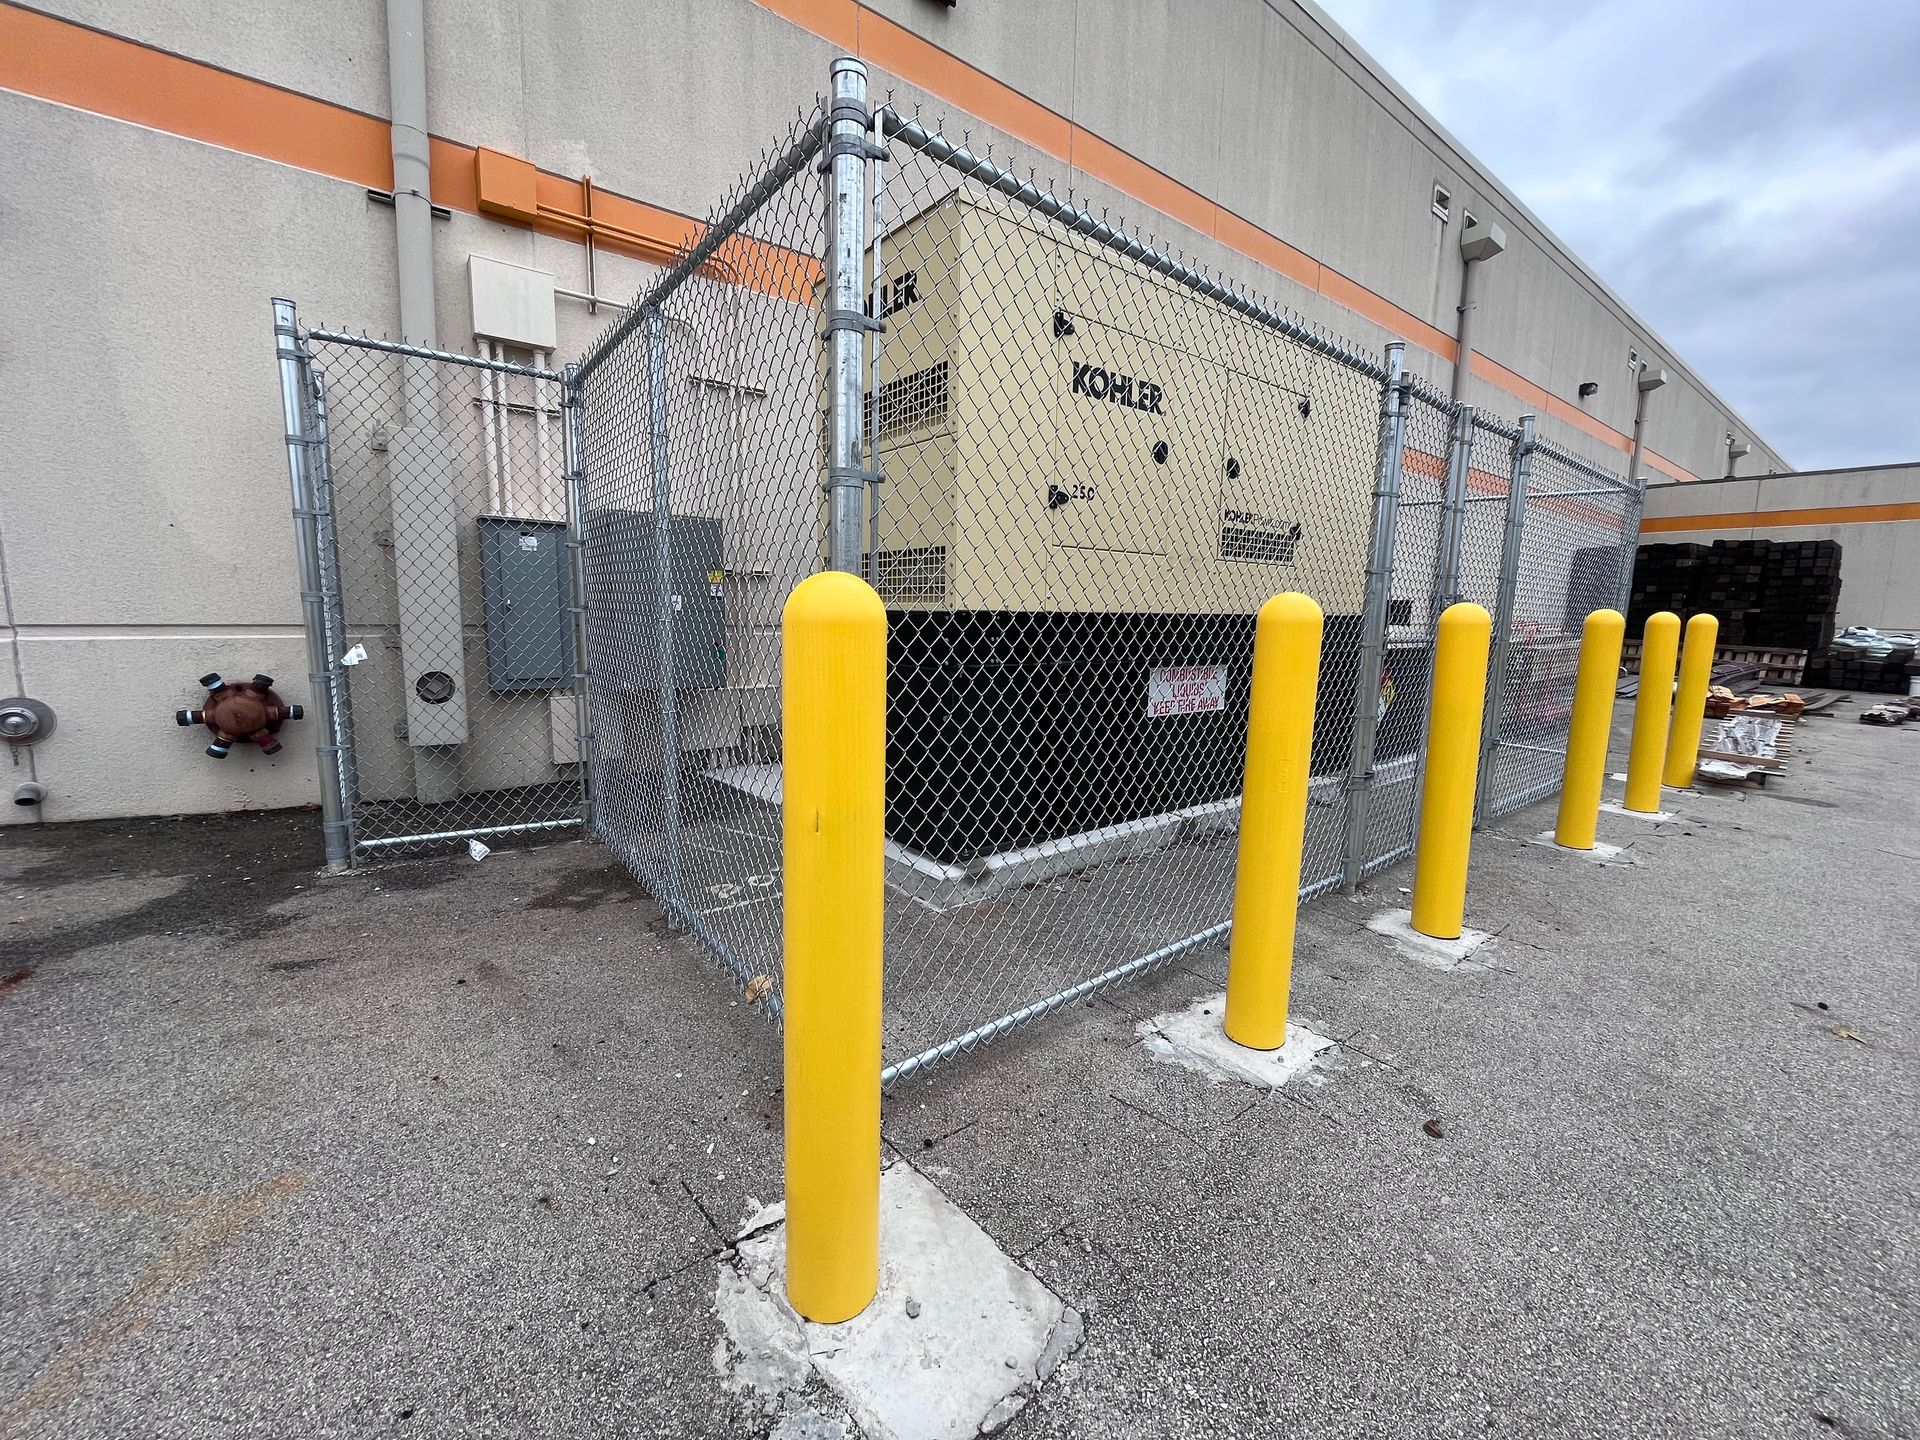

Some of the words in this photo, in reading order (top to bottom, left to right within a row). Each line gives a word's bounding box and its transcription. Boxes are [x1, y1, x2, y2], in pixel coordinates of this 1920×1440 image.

[1072, 361, 1164, 416] KOHLER
[1071, 484, 1095, 501] 250
[1172, 682, 1205, 698] LIQUIDS
[1197, 696, 1220, 710] AWAY
